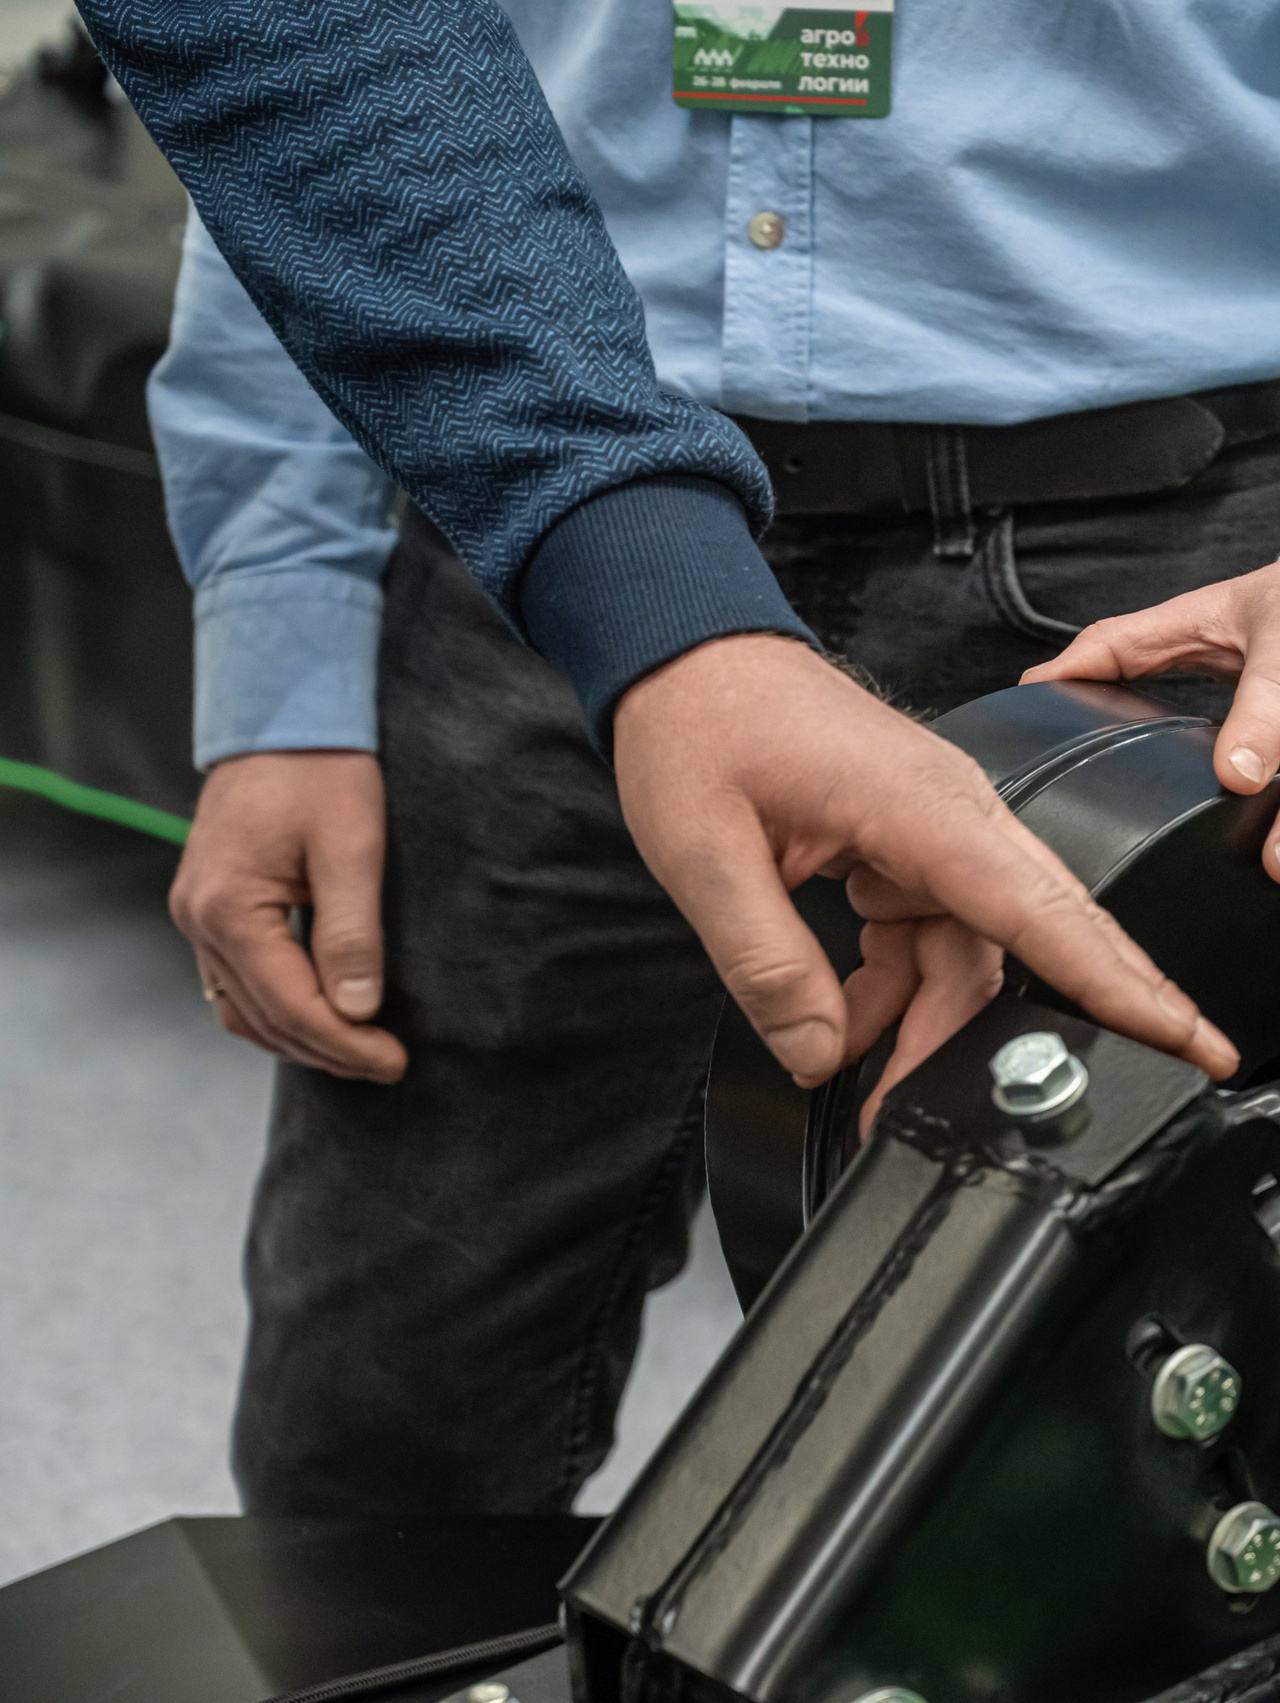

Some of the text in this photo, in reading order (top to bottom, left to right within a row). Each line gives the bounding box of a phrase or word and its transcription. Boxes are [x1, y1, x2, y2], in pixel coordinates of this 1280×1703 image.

[800, 28, 856, 48] агро
[800, 52, 870, 70] техно
[798, 75, 869, 93] логии
